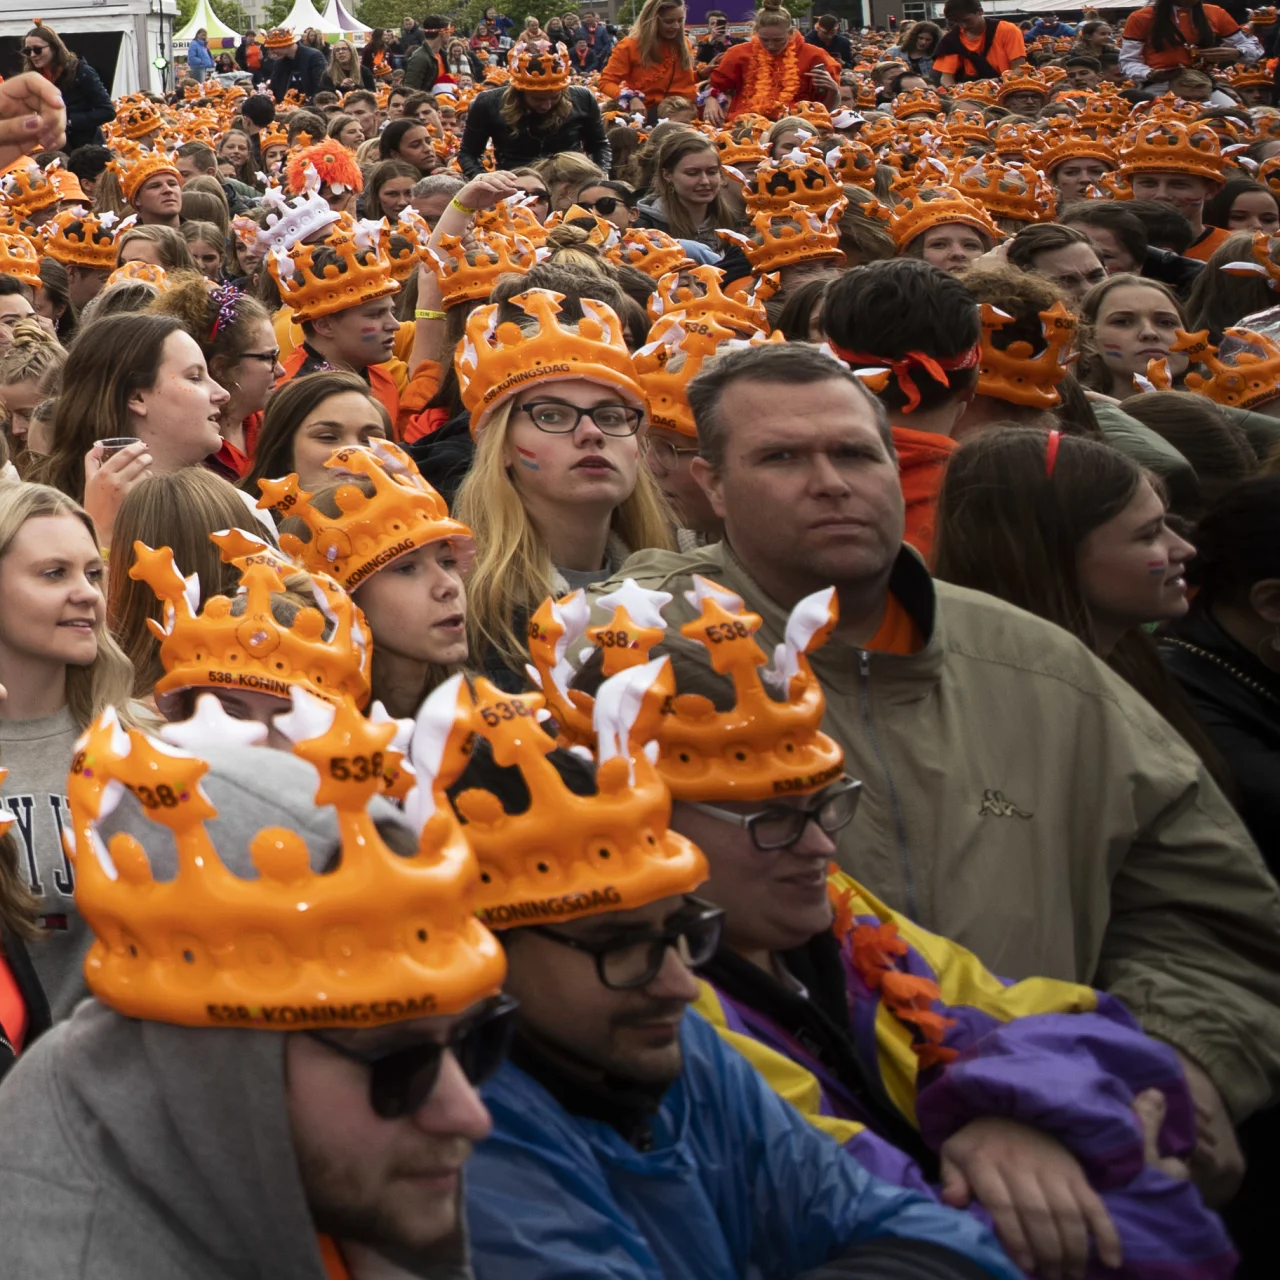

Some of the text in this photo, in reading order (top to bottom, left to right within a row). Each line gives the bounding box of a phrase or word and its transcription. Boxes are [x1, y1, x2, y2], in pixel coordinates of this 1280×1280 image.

[498, 363, 570, 392] KONINGSDAG
[245, 555, 277, 568] 538
[345, 537, 416, 587] KONINGSDAG
[596, 630, 628, 648] 538
[705, 620, 746, 644] 538
[208, 670, 233, 684] 538
[481, 700, 528, 727] 538
[484, 885, 622, 923] KONINGSDAG
[260, 993, 438, 1023] KONINGSDAG
